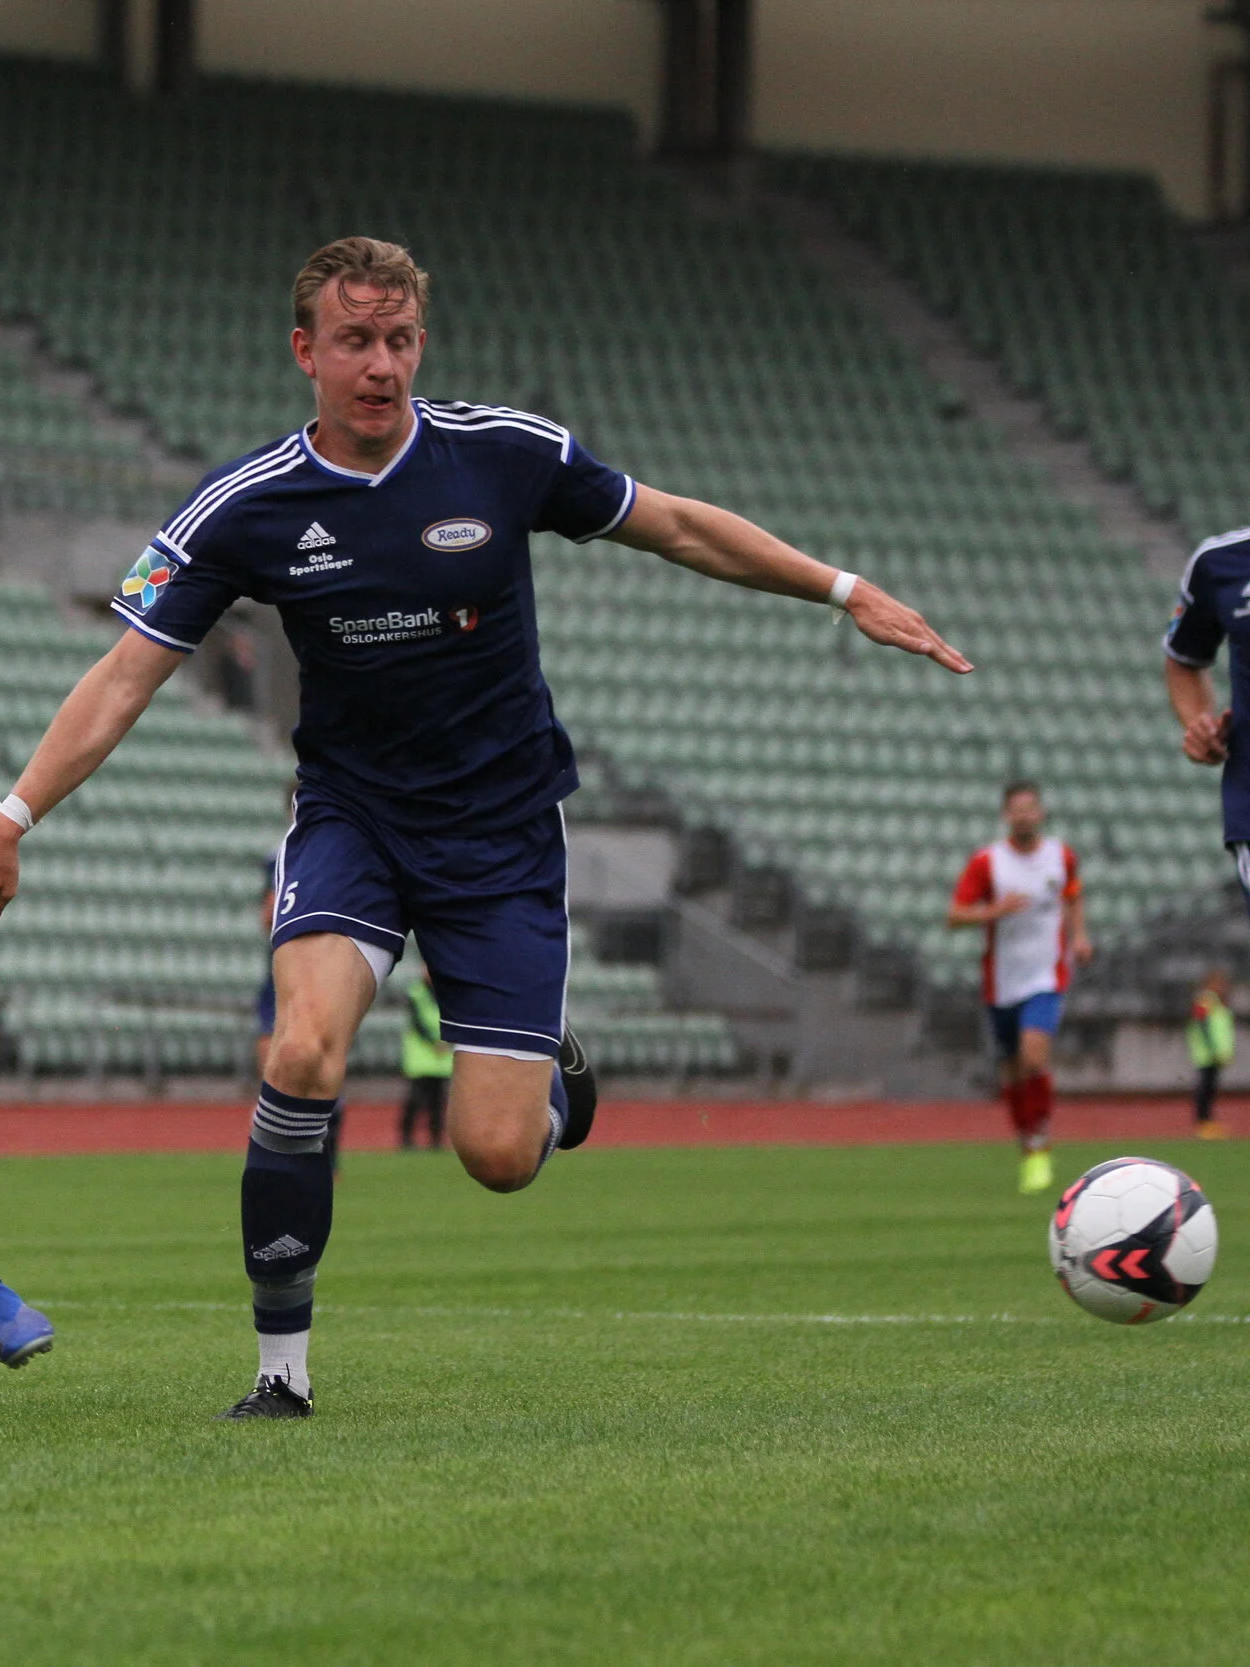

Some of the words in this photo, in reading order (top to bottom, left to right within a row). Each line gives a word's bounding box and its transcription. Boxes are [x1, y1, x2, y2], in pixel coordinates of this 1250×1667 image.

[297, 536, 337, 550] adidas
[437, 527, 477, 542] Ready
[308, 552, 334, 564] Oslo
[289, 558, 354, 576] Sportslager
[329, 607, 442, 634] SpareBank
[456, 608, 469, 629] 1
[280, 880, 299, 915] 5
[253, 1244, 309, 1261] adidas
